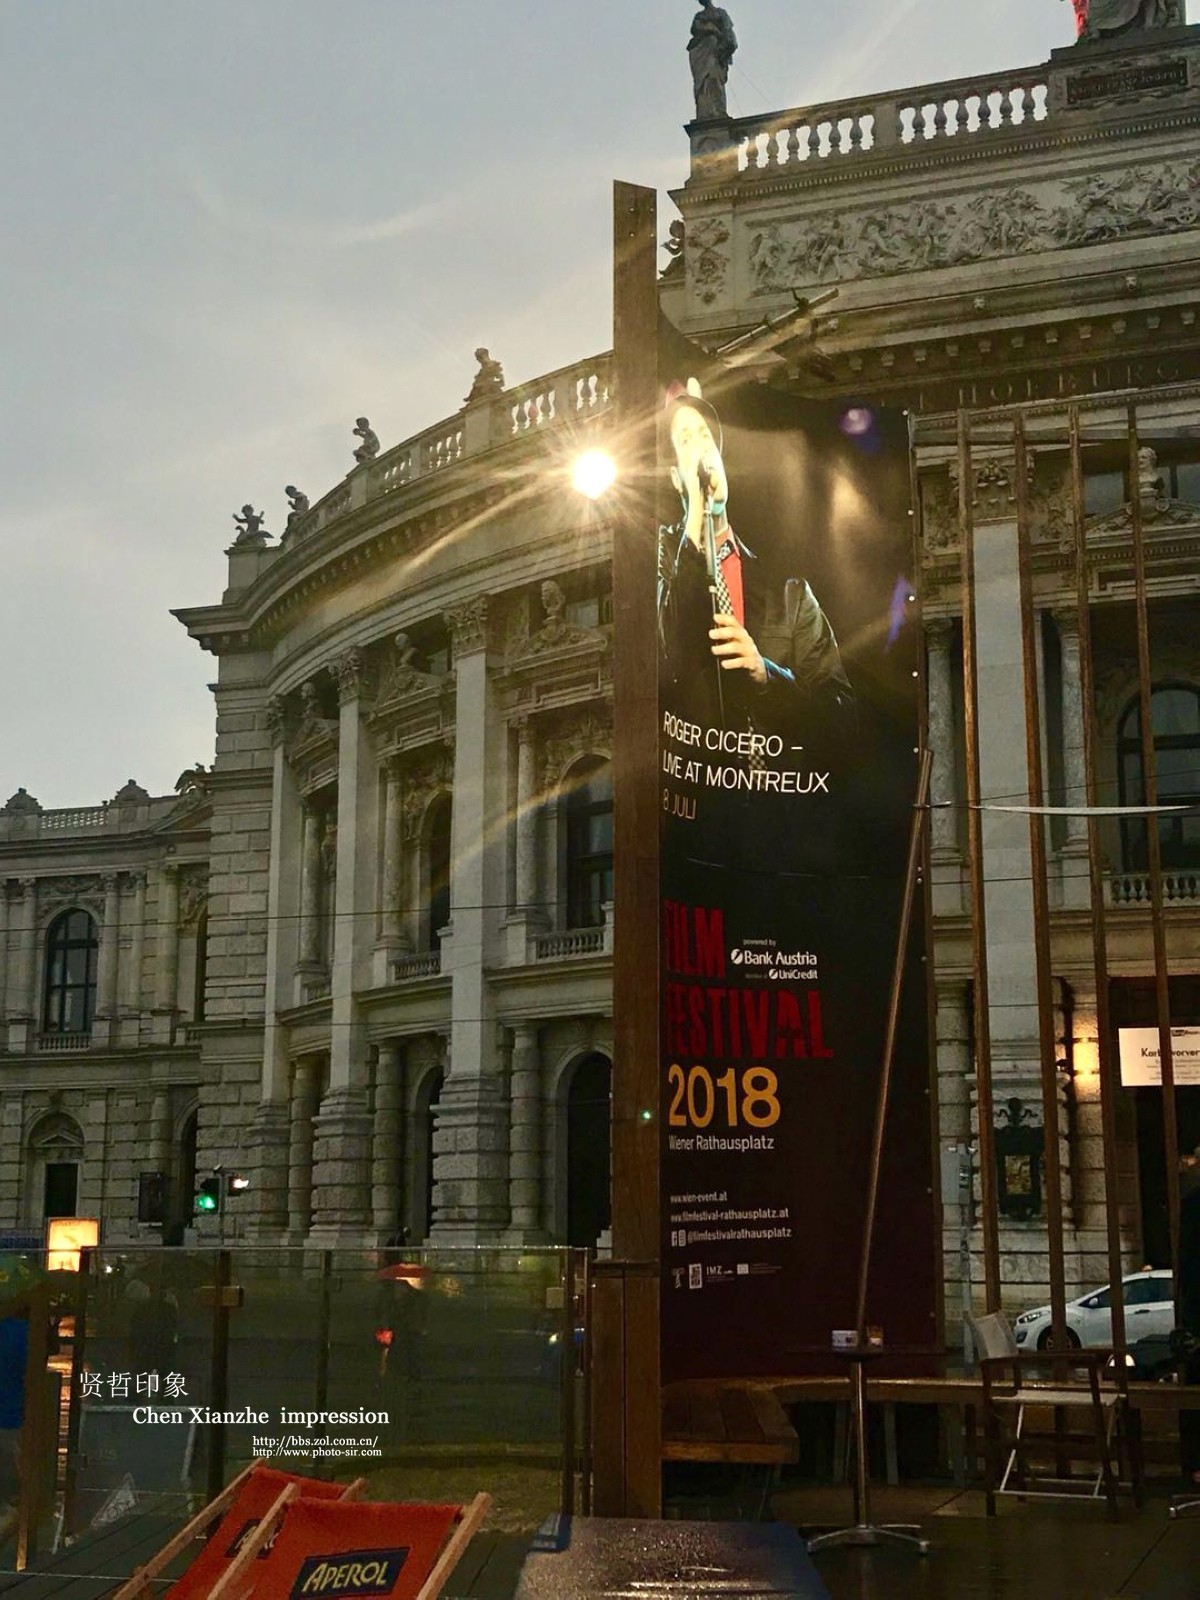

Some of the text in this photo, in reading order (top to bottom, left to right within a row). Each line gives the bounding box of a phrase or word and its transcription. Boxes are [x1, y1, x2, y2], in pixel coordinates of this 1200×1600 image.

[663, 710, 701, 747] ROGER
[705, 727, 783, 757] CICERO
[662, 749, 830, 793] LIVE AT MONTREUX
[672, 793, 697, 820] JULI
[744, 949, 818, 966] Bank Austria
[778, 968, 818, 980] UniCredit
[666, 983, 834, 1059] FESTIVAL
[667, 1063, 781, 1129] 2018
[668, 1134, 775, 1153] Wiener Rathausplatz
[706, 1265, 722, 1275] IMZ
[301, 1561, 389, 1592] APEROL
